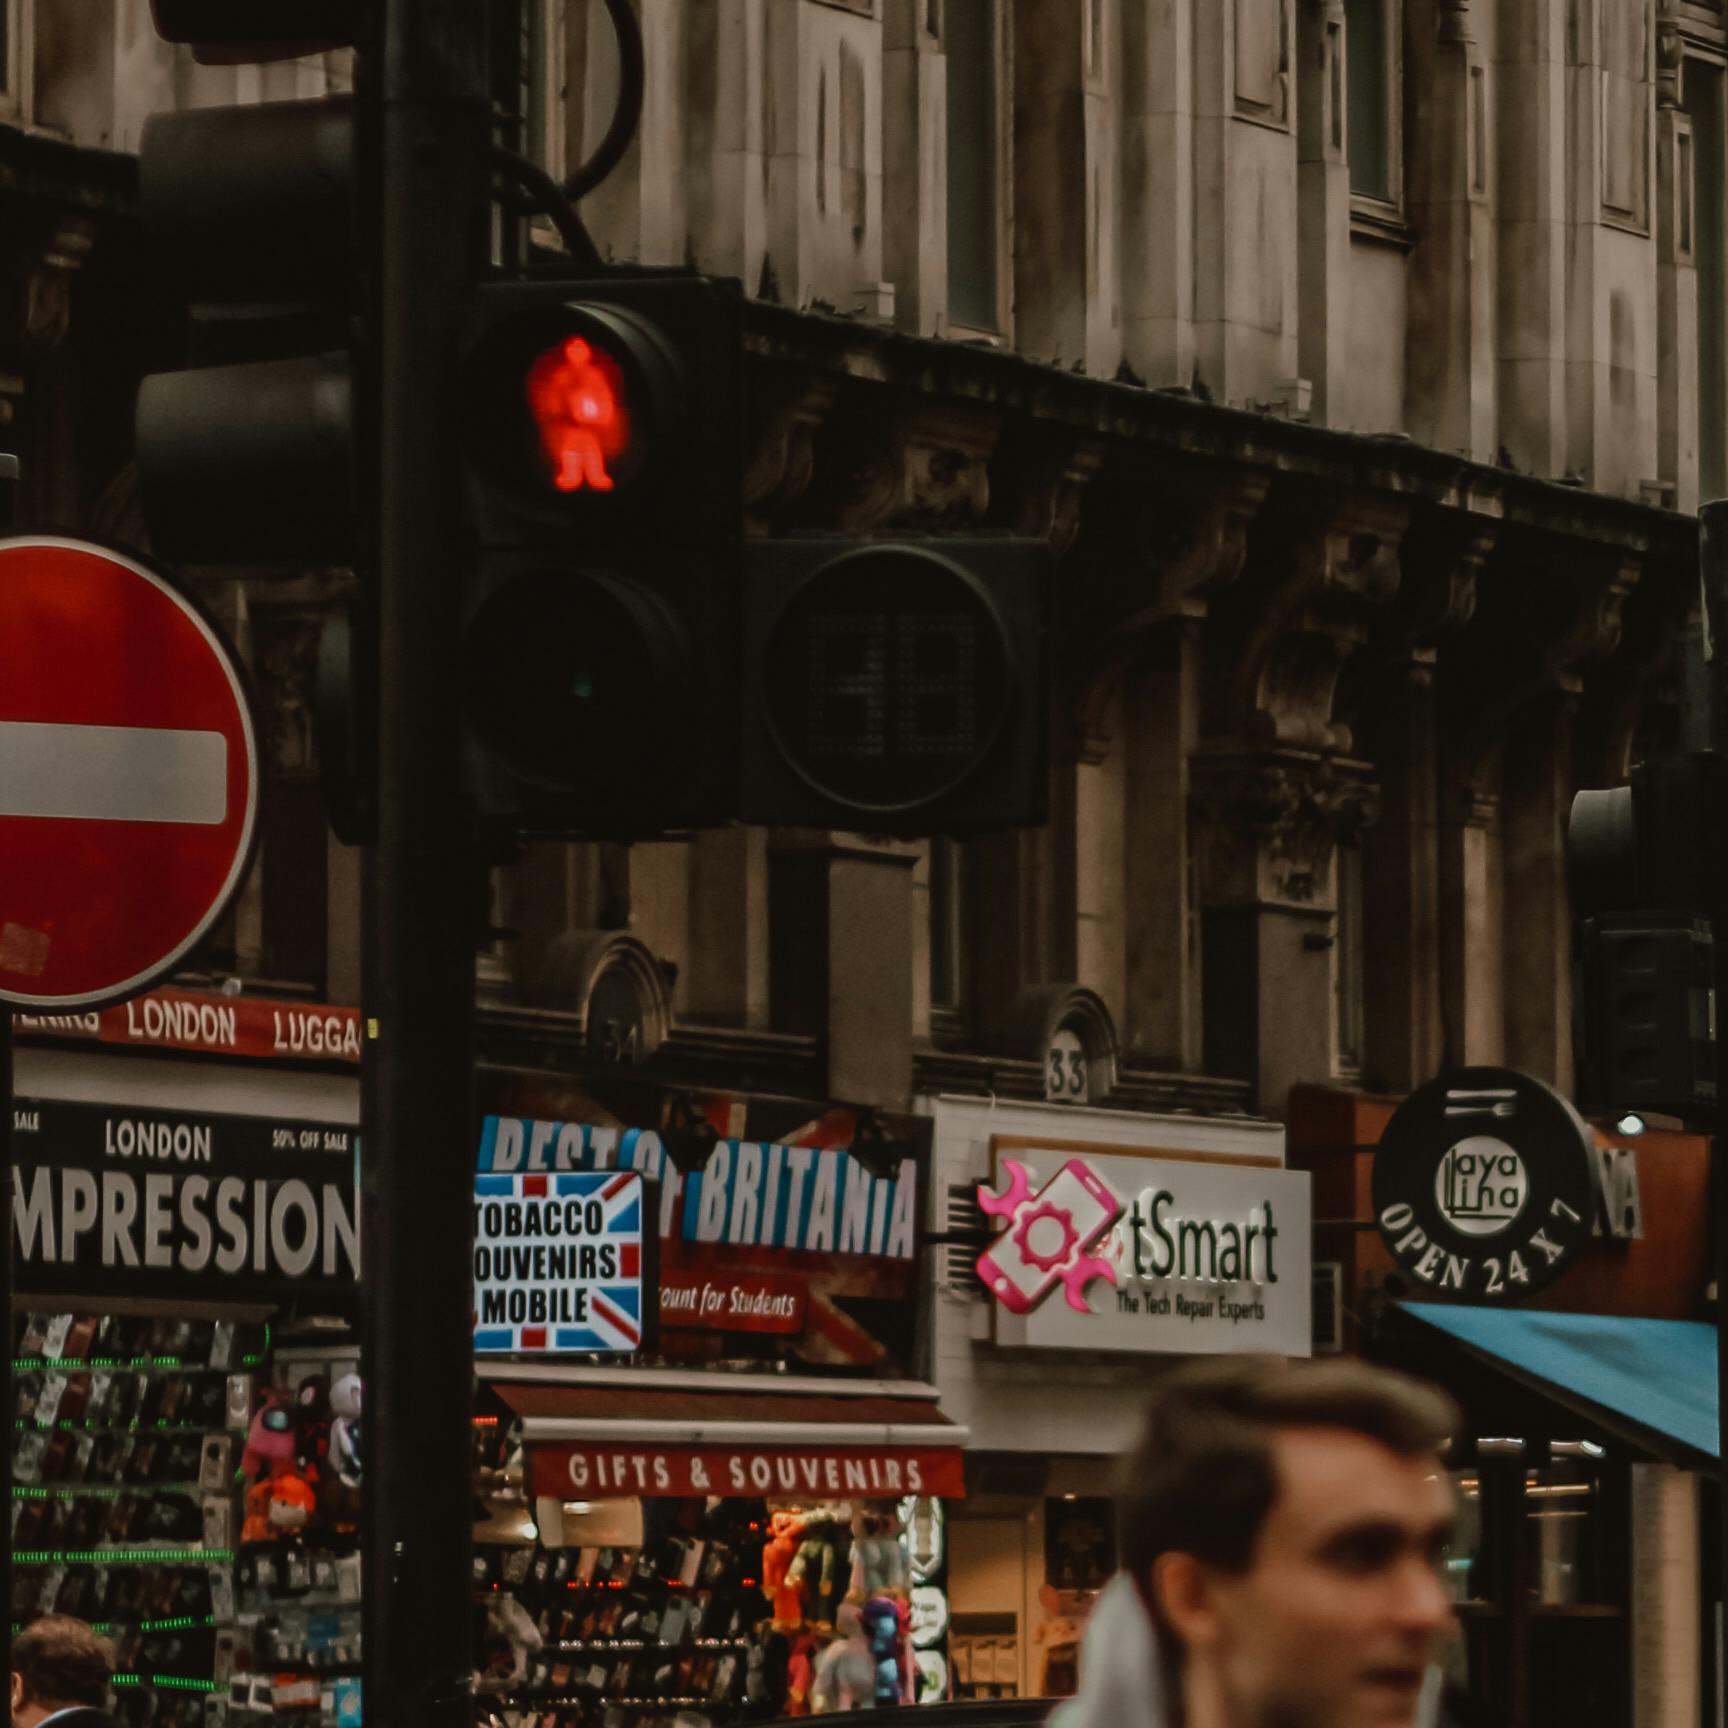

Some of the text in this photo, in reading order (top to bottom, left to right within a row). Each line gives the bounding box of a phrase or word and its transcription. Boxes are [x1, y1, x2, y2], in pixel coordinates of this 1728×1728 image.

[127, 999, 236, 1046] LONDON
[273, 1010, 362, 1054] LUGGA
[1047, 1048, 1087, 1093] 33
[105, 1119, 212, 1162] LONDON
[272, 1129, 348, 1152] 50% OFF SALE
[695, 1139, 918, 1261] BRITANIA
[12, 1164, 361, 1282] MPRESSION
[474, 1243, 616, 1281] OUVENIRS
[1380, 1201, 1471, 1290] OPEN
[1482, 1249, 1530, 1294] 24
[1549, 1197, 1582, 1223] 7
[482, 1287, 589, 1324] MOBILE
[659, 1283, 797, 1318] ount for Students
[1116, 1290, 1265, 1324] The Tech Repair Experts
[567, 1453, 926, 1492] GIFTS & SOUVENIRS
